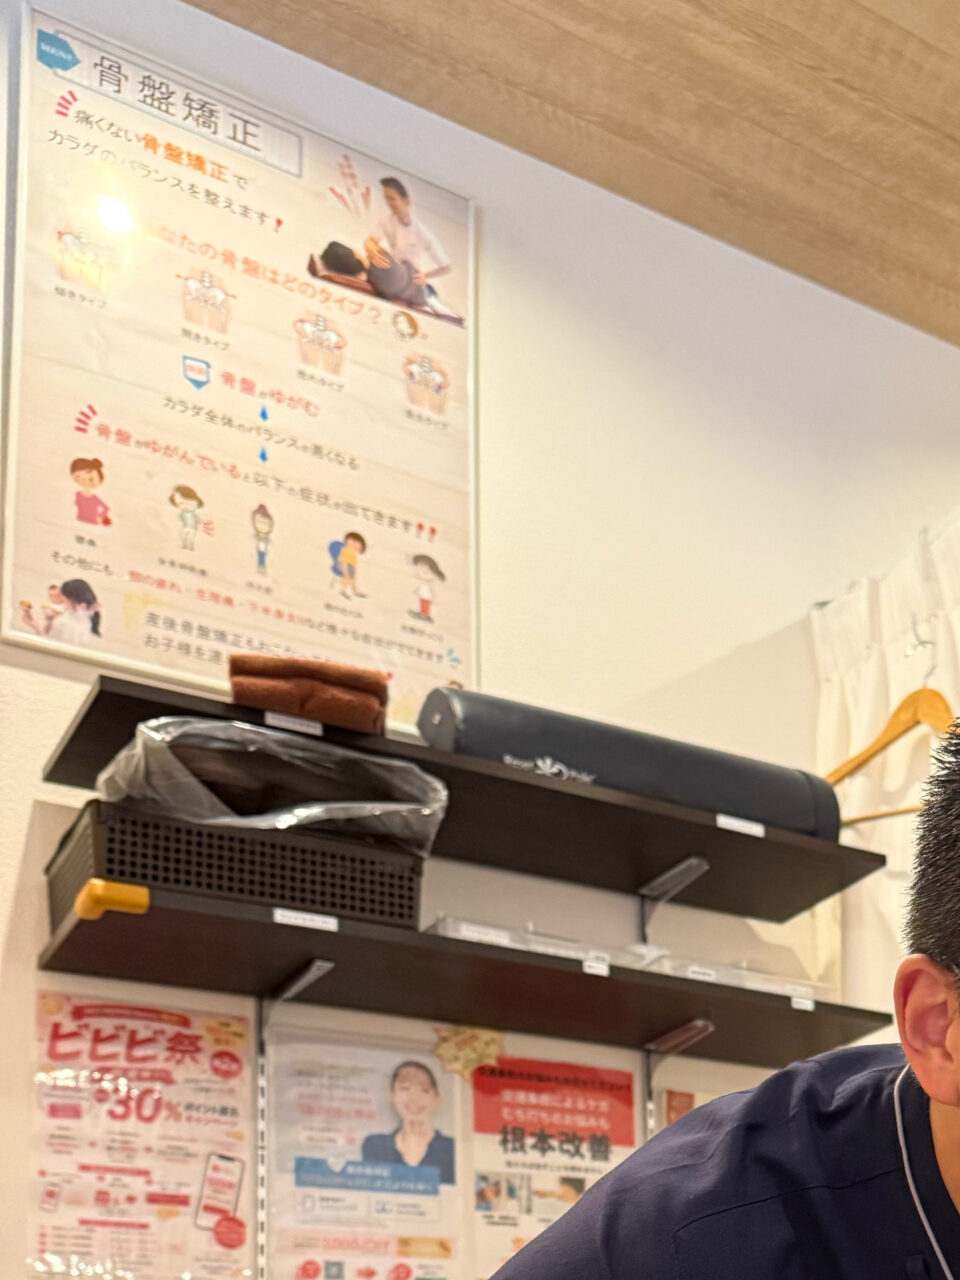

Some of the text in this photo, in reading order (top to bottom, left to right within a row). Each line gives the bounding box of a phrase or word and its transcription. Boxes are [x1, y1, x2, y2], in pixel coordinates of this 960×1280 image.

[94, 56, 262, 151] 骨盤矯正
[74, 109, 249, 190] 痛くない骨盤矯正で
[157, 223, 383, 325] なたの骨盤はどのタイプ？
[47, 1022, 203, 1065] ビビビ祭
[500, 1124, 613, 1162] 根本改善
